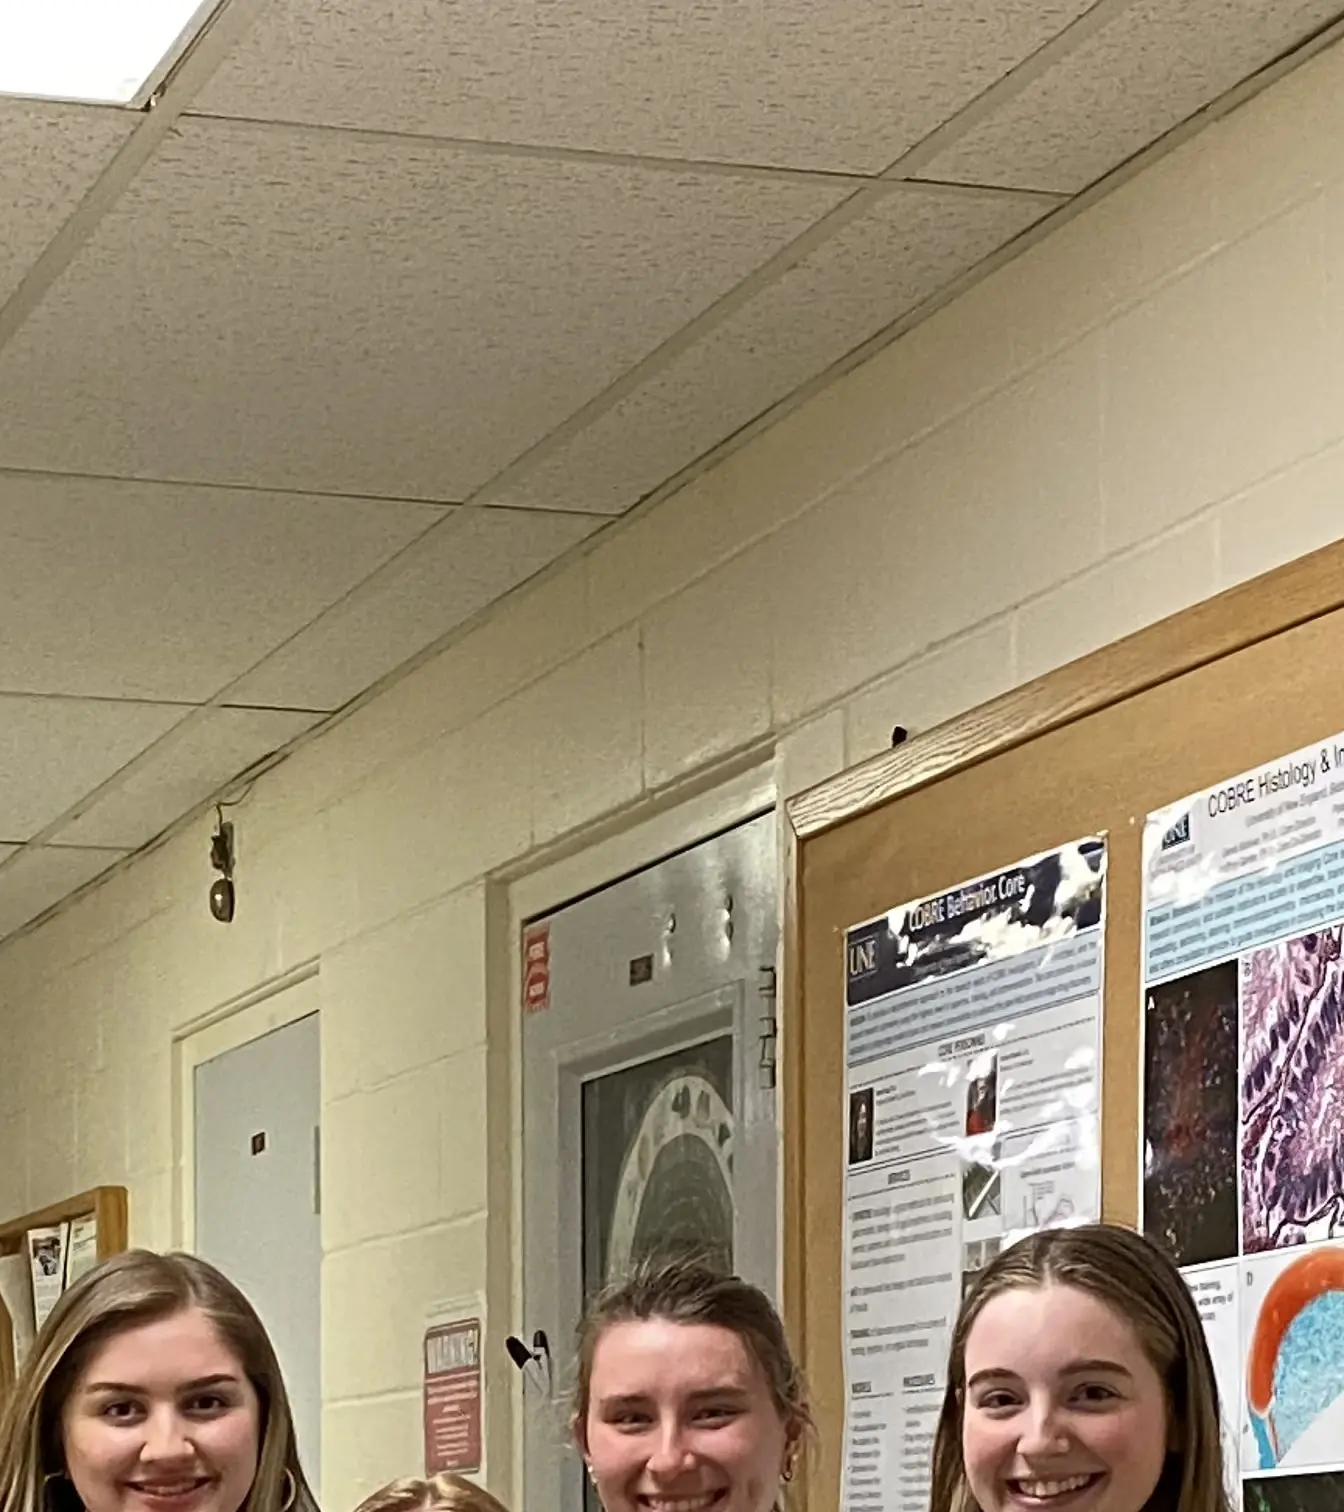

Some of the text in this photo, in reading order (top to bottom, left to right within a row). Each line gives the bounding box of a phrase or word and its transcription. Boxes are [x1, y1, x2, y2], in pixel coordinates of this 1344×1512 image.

[1207, 781, 1255, 817] COBRE
[1257, 761, 1316, 797] Histology
[1319, 751, 1331, 774] &
